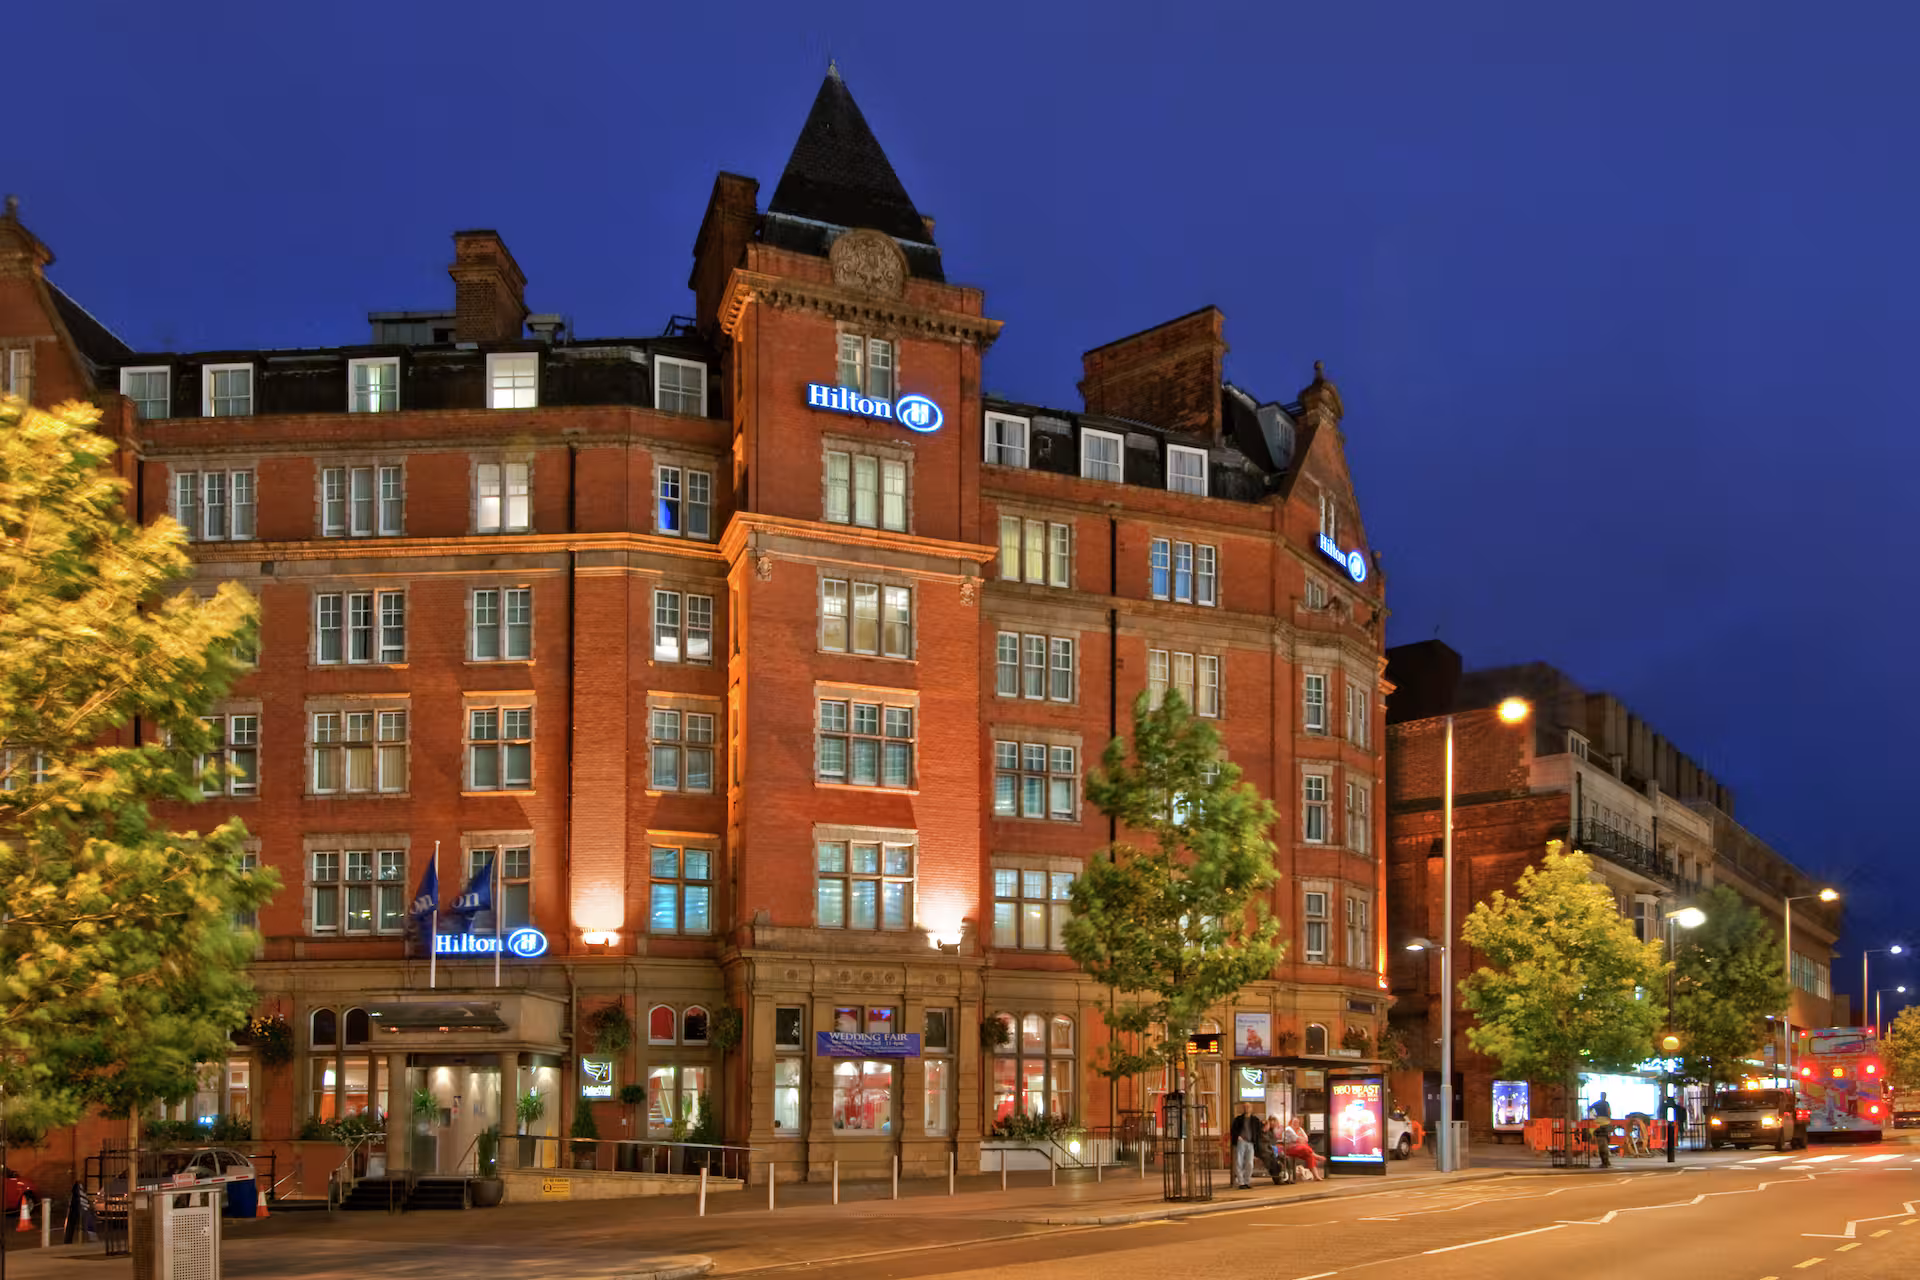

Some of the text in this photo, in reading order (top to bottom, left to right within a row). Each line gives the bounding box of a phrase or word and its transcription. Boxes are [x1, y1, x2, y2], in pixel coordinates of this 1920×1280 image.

[808, 384, 892, 418] Hilton
[1320, 532, 1346, 567] Hilton
[435, 933, 503, 953] Hilton
[829, 1032, 908, 1041] WEDDING FAIR
[1333, 1085, 1350, 1095] BBQ
